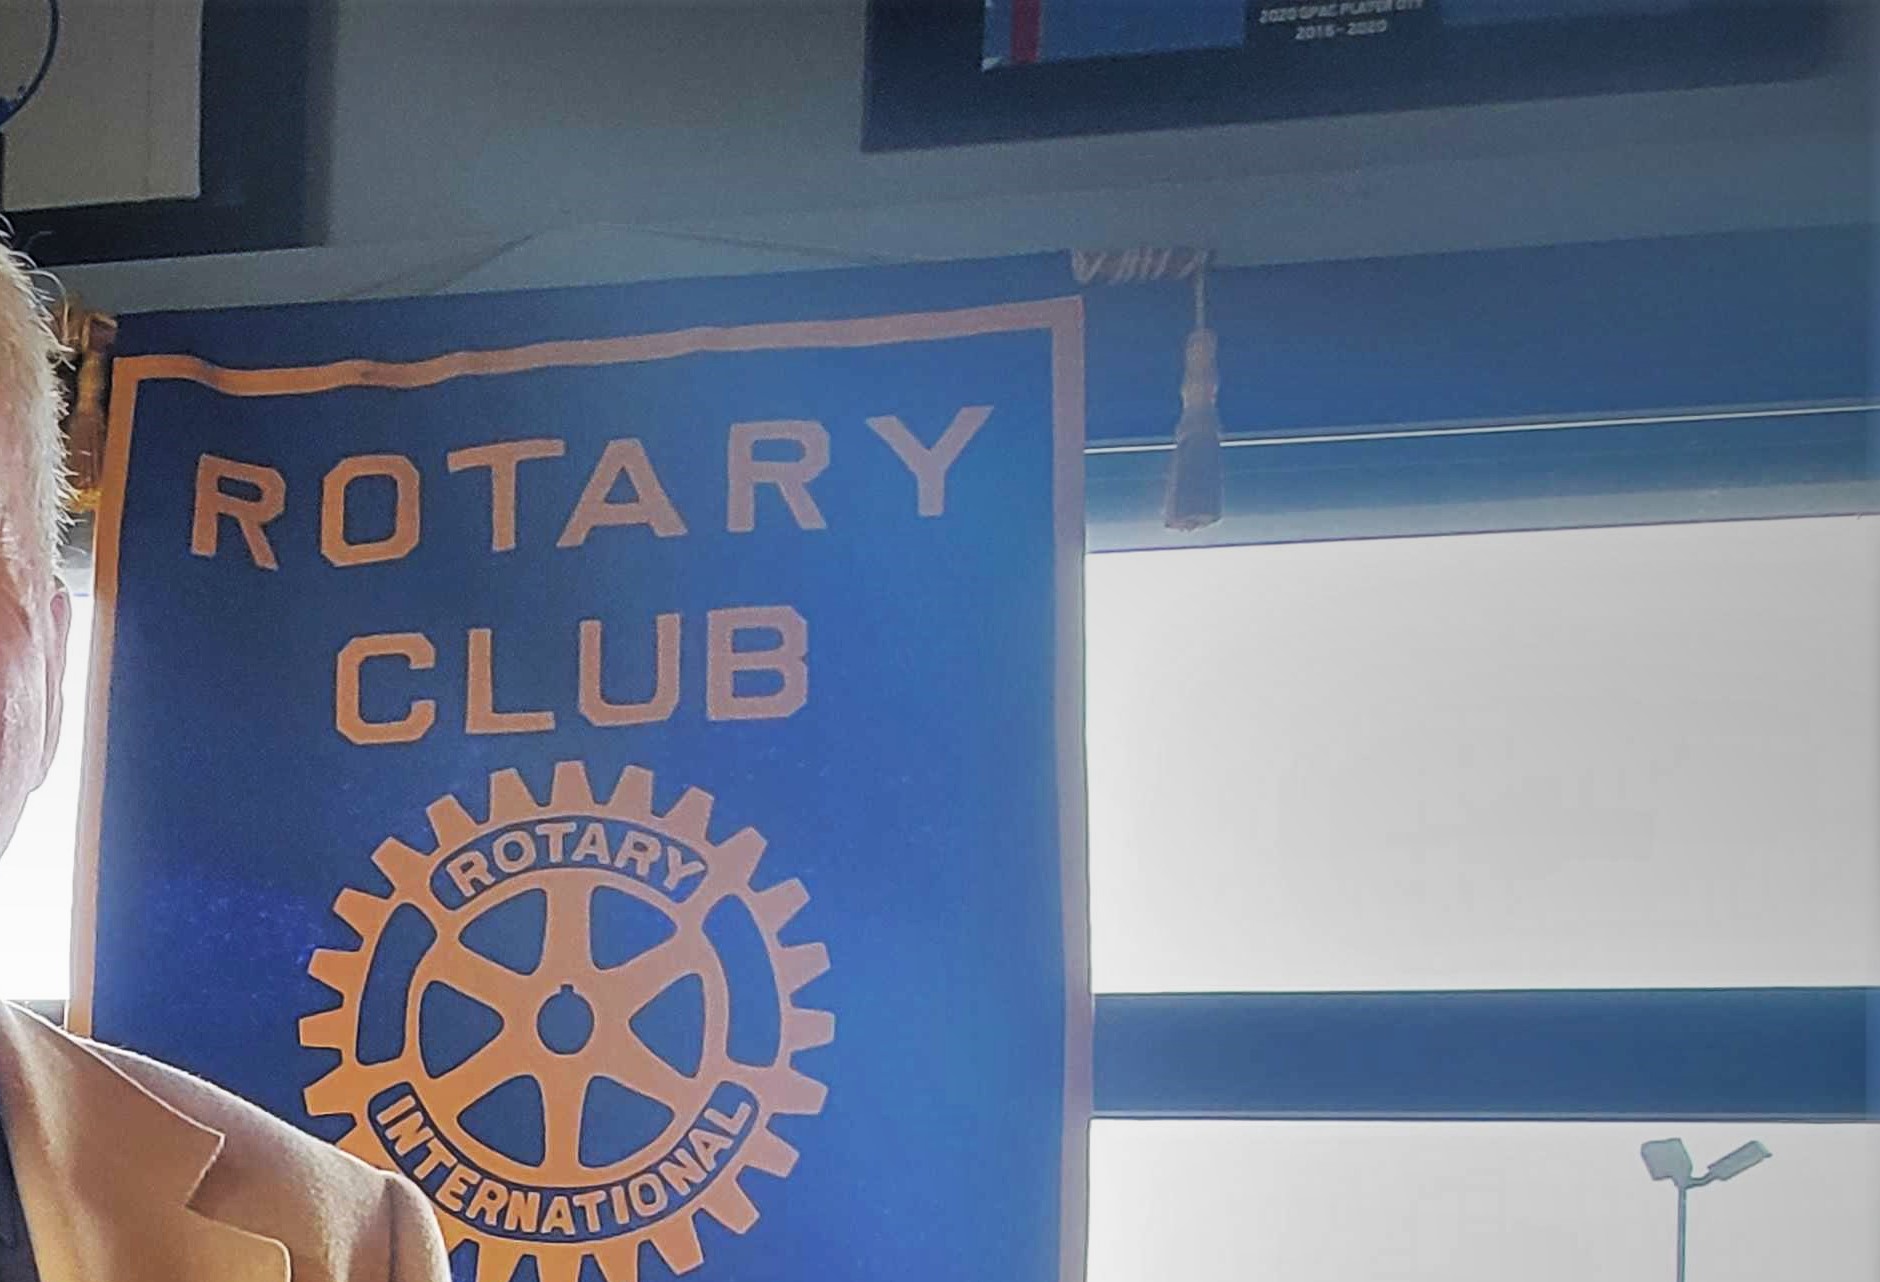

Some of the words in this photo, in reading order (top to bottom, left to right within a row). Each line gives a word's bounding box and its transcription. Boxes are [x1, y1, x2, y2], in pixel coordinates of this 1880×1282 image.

[191, 405, 995, 571] ROTARY
[335, 605, 810, 746] CLUB
[446, 821, 707, 899] ROTARY
[376, 1094, 753, 1236] INTERNATIONAL
